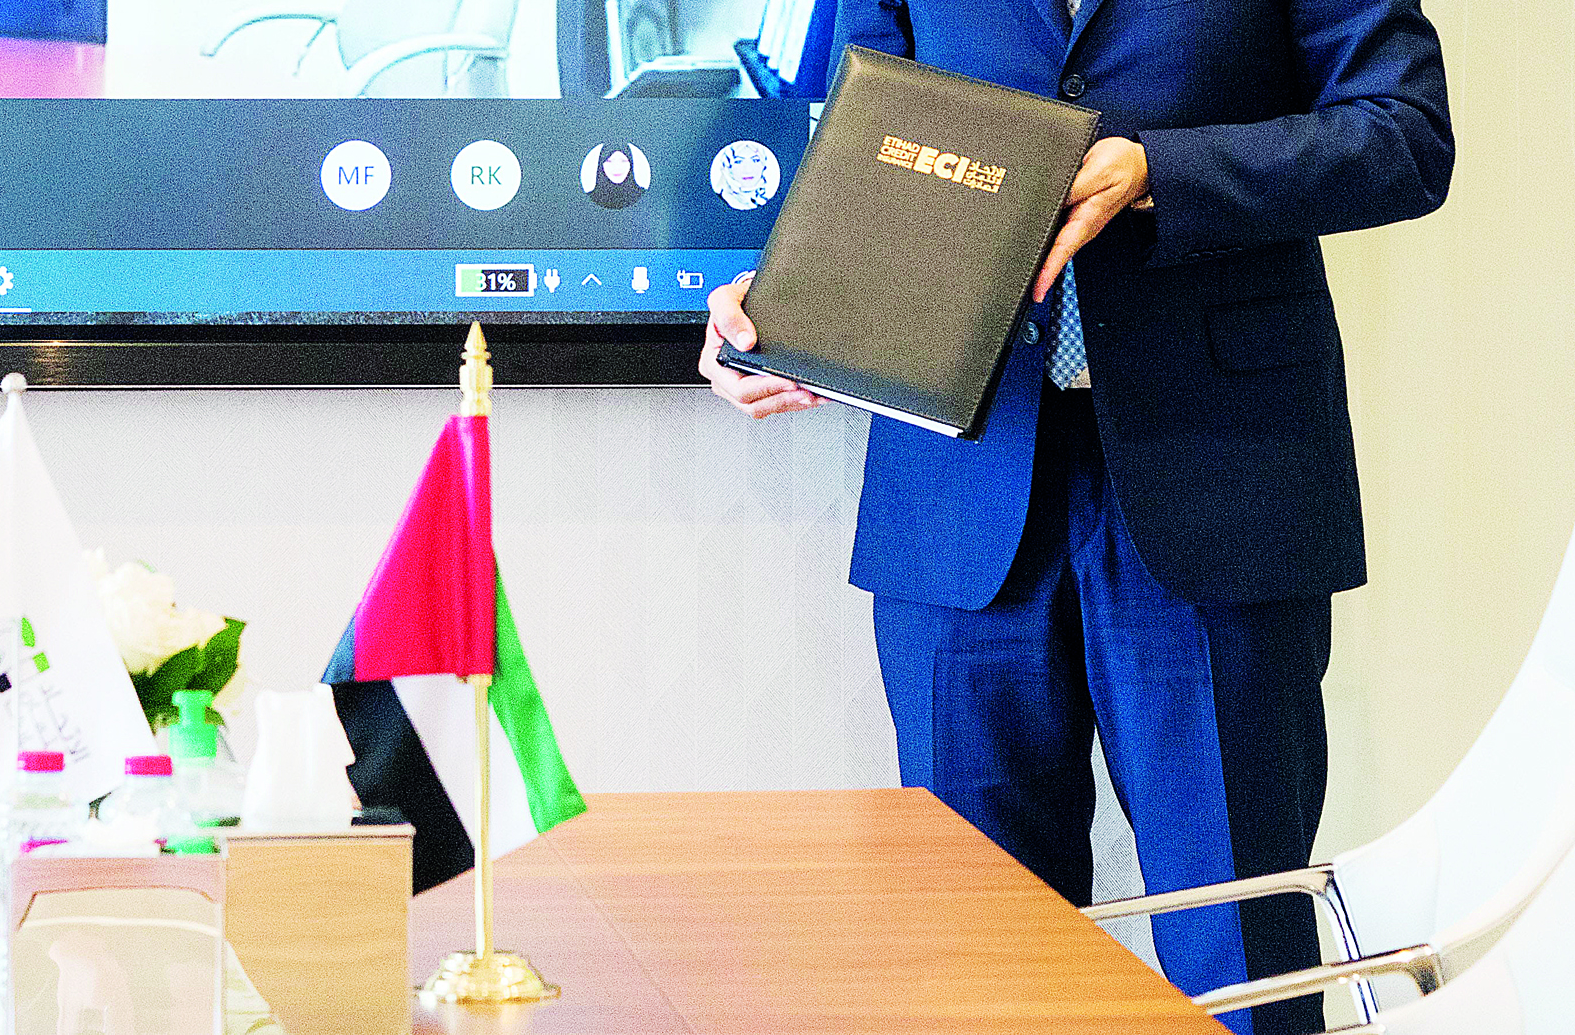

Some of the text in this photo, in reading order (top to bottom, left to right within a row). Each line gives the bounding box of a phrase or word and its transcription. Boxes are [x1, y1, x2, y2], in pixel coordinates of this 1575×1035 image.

[882, 134, 921, 153] ETIHAD
[880, 146, 918, 162] CREDIT
[913, 145, 971, 184] ECI
[338, 166, 375, 185] MF
[470, 166, 502, 185] RK
[475, 272, 516, 291] 31%
